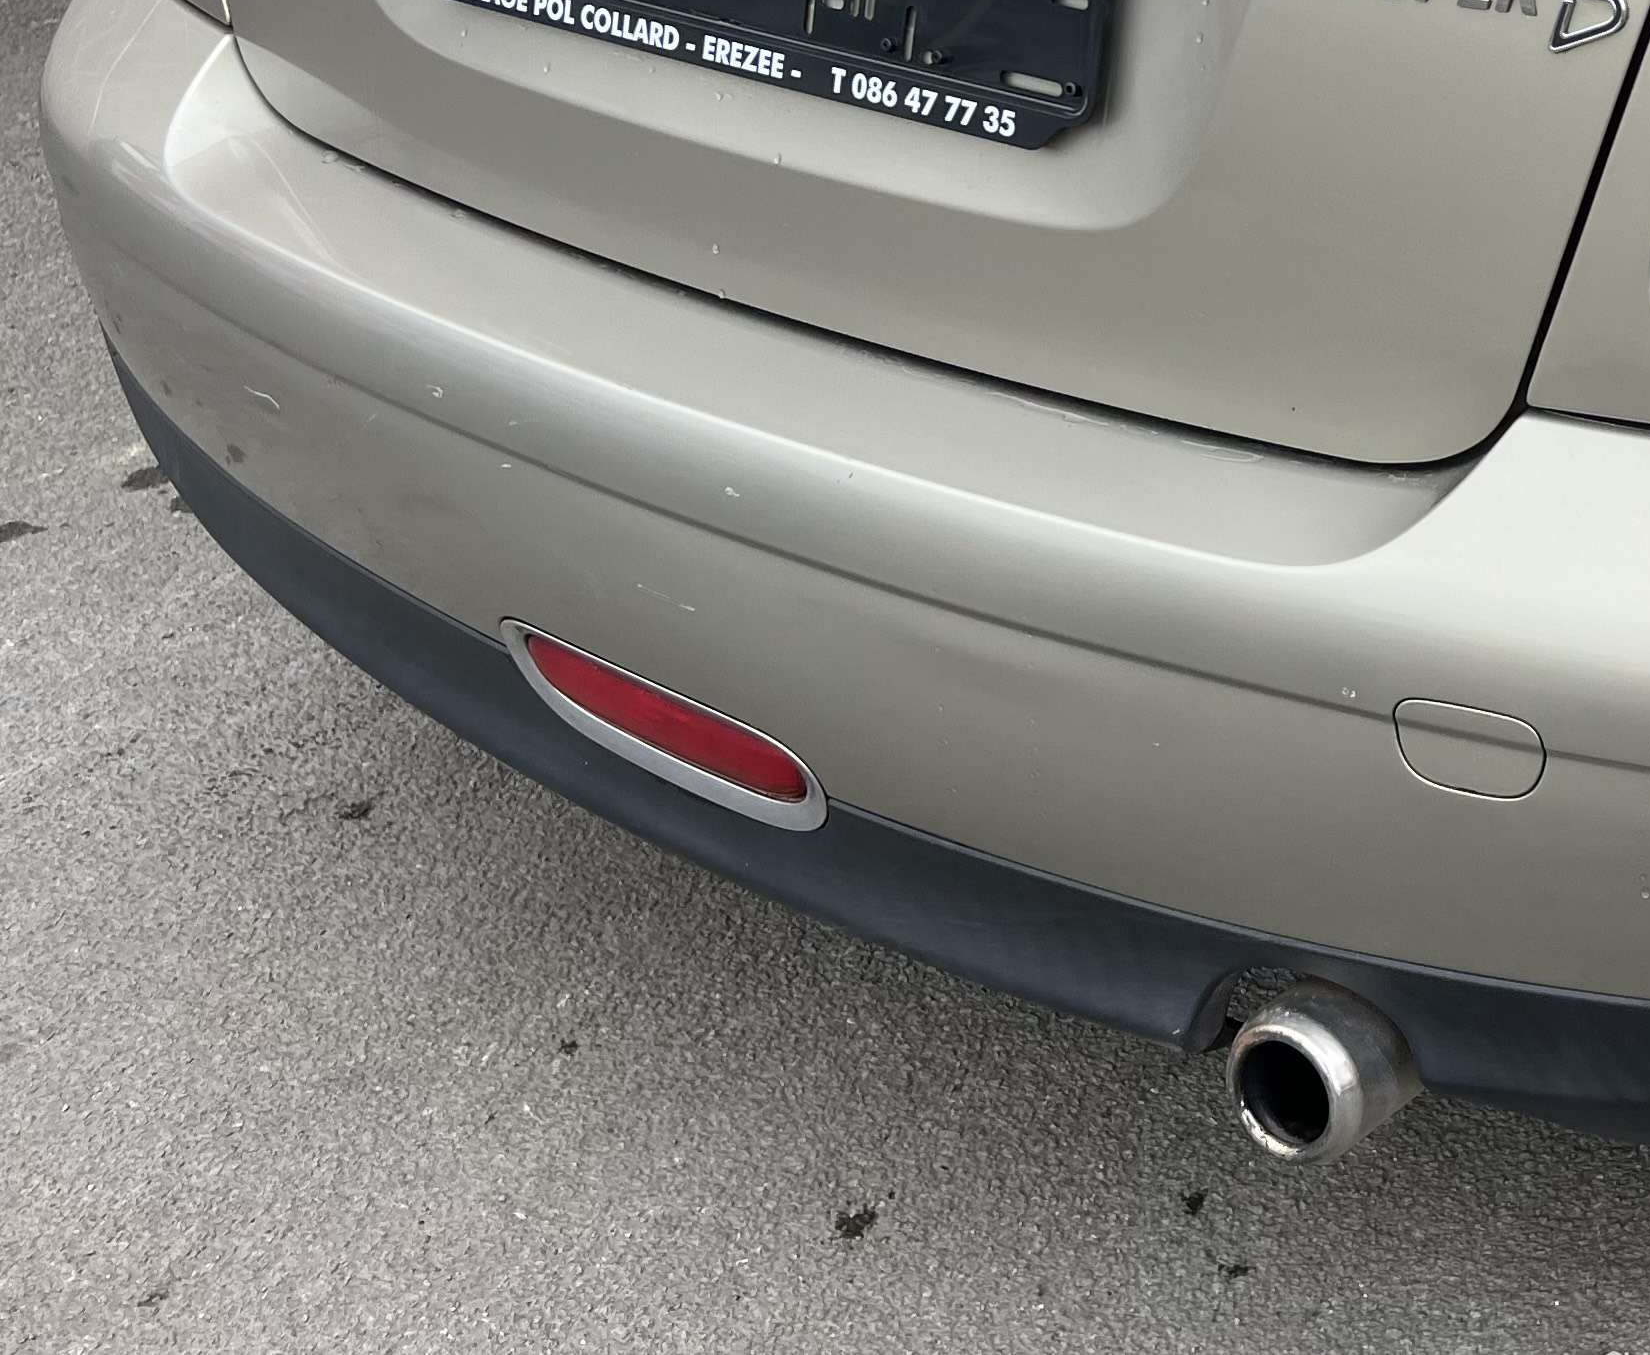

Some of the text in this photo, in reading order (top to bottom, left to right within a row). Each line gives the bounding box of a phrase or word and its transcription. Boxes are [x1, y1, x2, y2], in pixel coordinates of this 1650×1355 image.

[580, 4, 680, 51] COLLARD
[702, 34, 786, 79] EREZEE
[831, 66, 847, 94] T
[851, 72, 898, 108] 086
[904, 86, 938, 116] 47
[944, 95, 978, 126] 77
[982, 104, 1016, 137] 35
